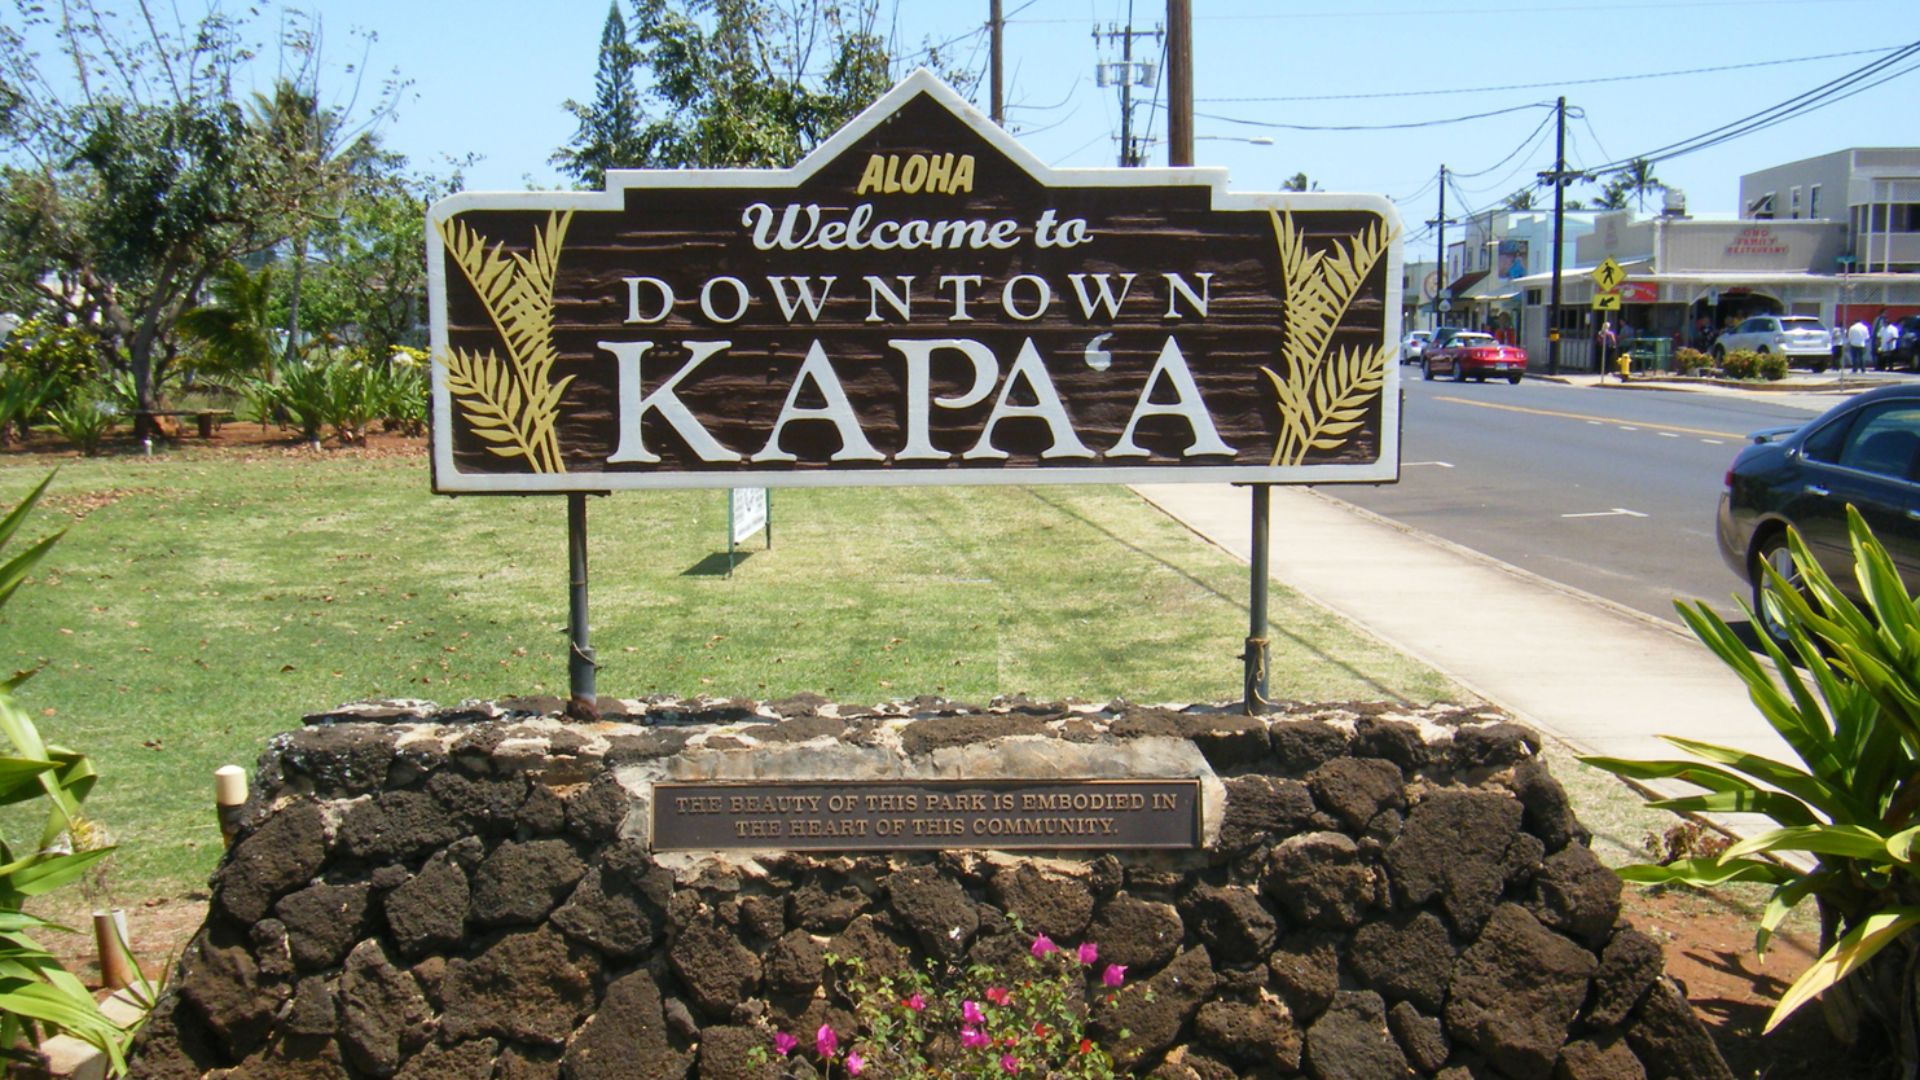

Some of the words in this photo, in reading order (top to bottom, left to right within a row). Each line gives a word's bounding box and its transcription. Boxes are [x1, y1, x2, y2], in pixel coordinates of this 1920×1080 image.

[857, 152, 974, 194] ALOHA
[741, 202, 1021, 252] Welcome
[1034, 208, 1094, 248] to
[1736, 237, 1777, 246] FAMILY
[622, 272, 1212, 324] DOWNTOWN
[675, 796, 722, 814] THE
[729, 795, 822, 813] BEAUTY
[828, 794, 860, 812] OF
[865, 794, 918, 812] THIS
[925, 794, 987, 811] PARK
[993, 793, 1015, 811] IS
[1021, 793, 1145, 811] EMBODIED
[1151, 793, 1178, 810] IN
[735, 819, 782, 837] THE
[788, 818, 869, 837] HEART
[875, 818, 907, 836] OF
[912, 818, 965, 836] THIS
[972, 817, 1119, 835] COMMUNITY.
